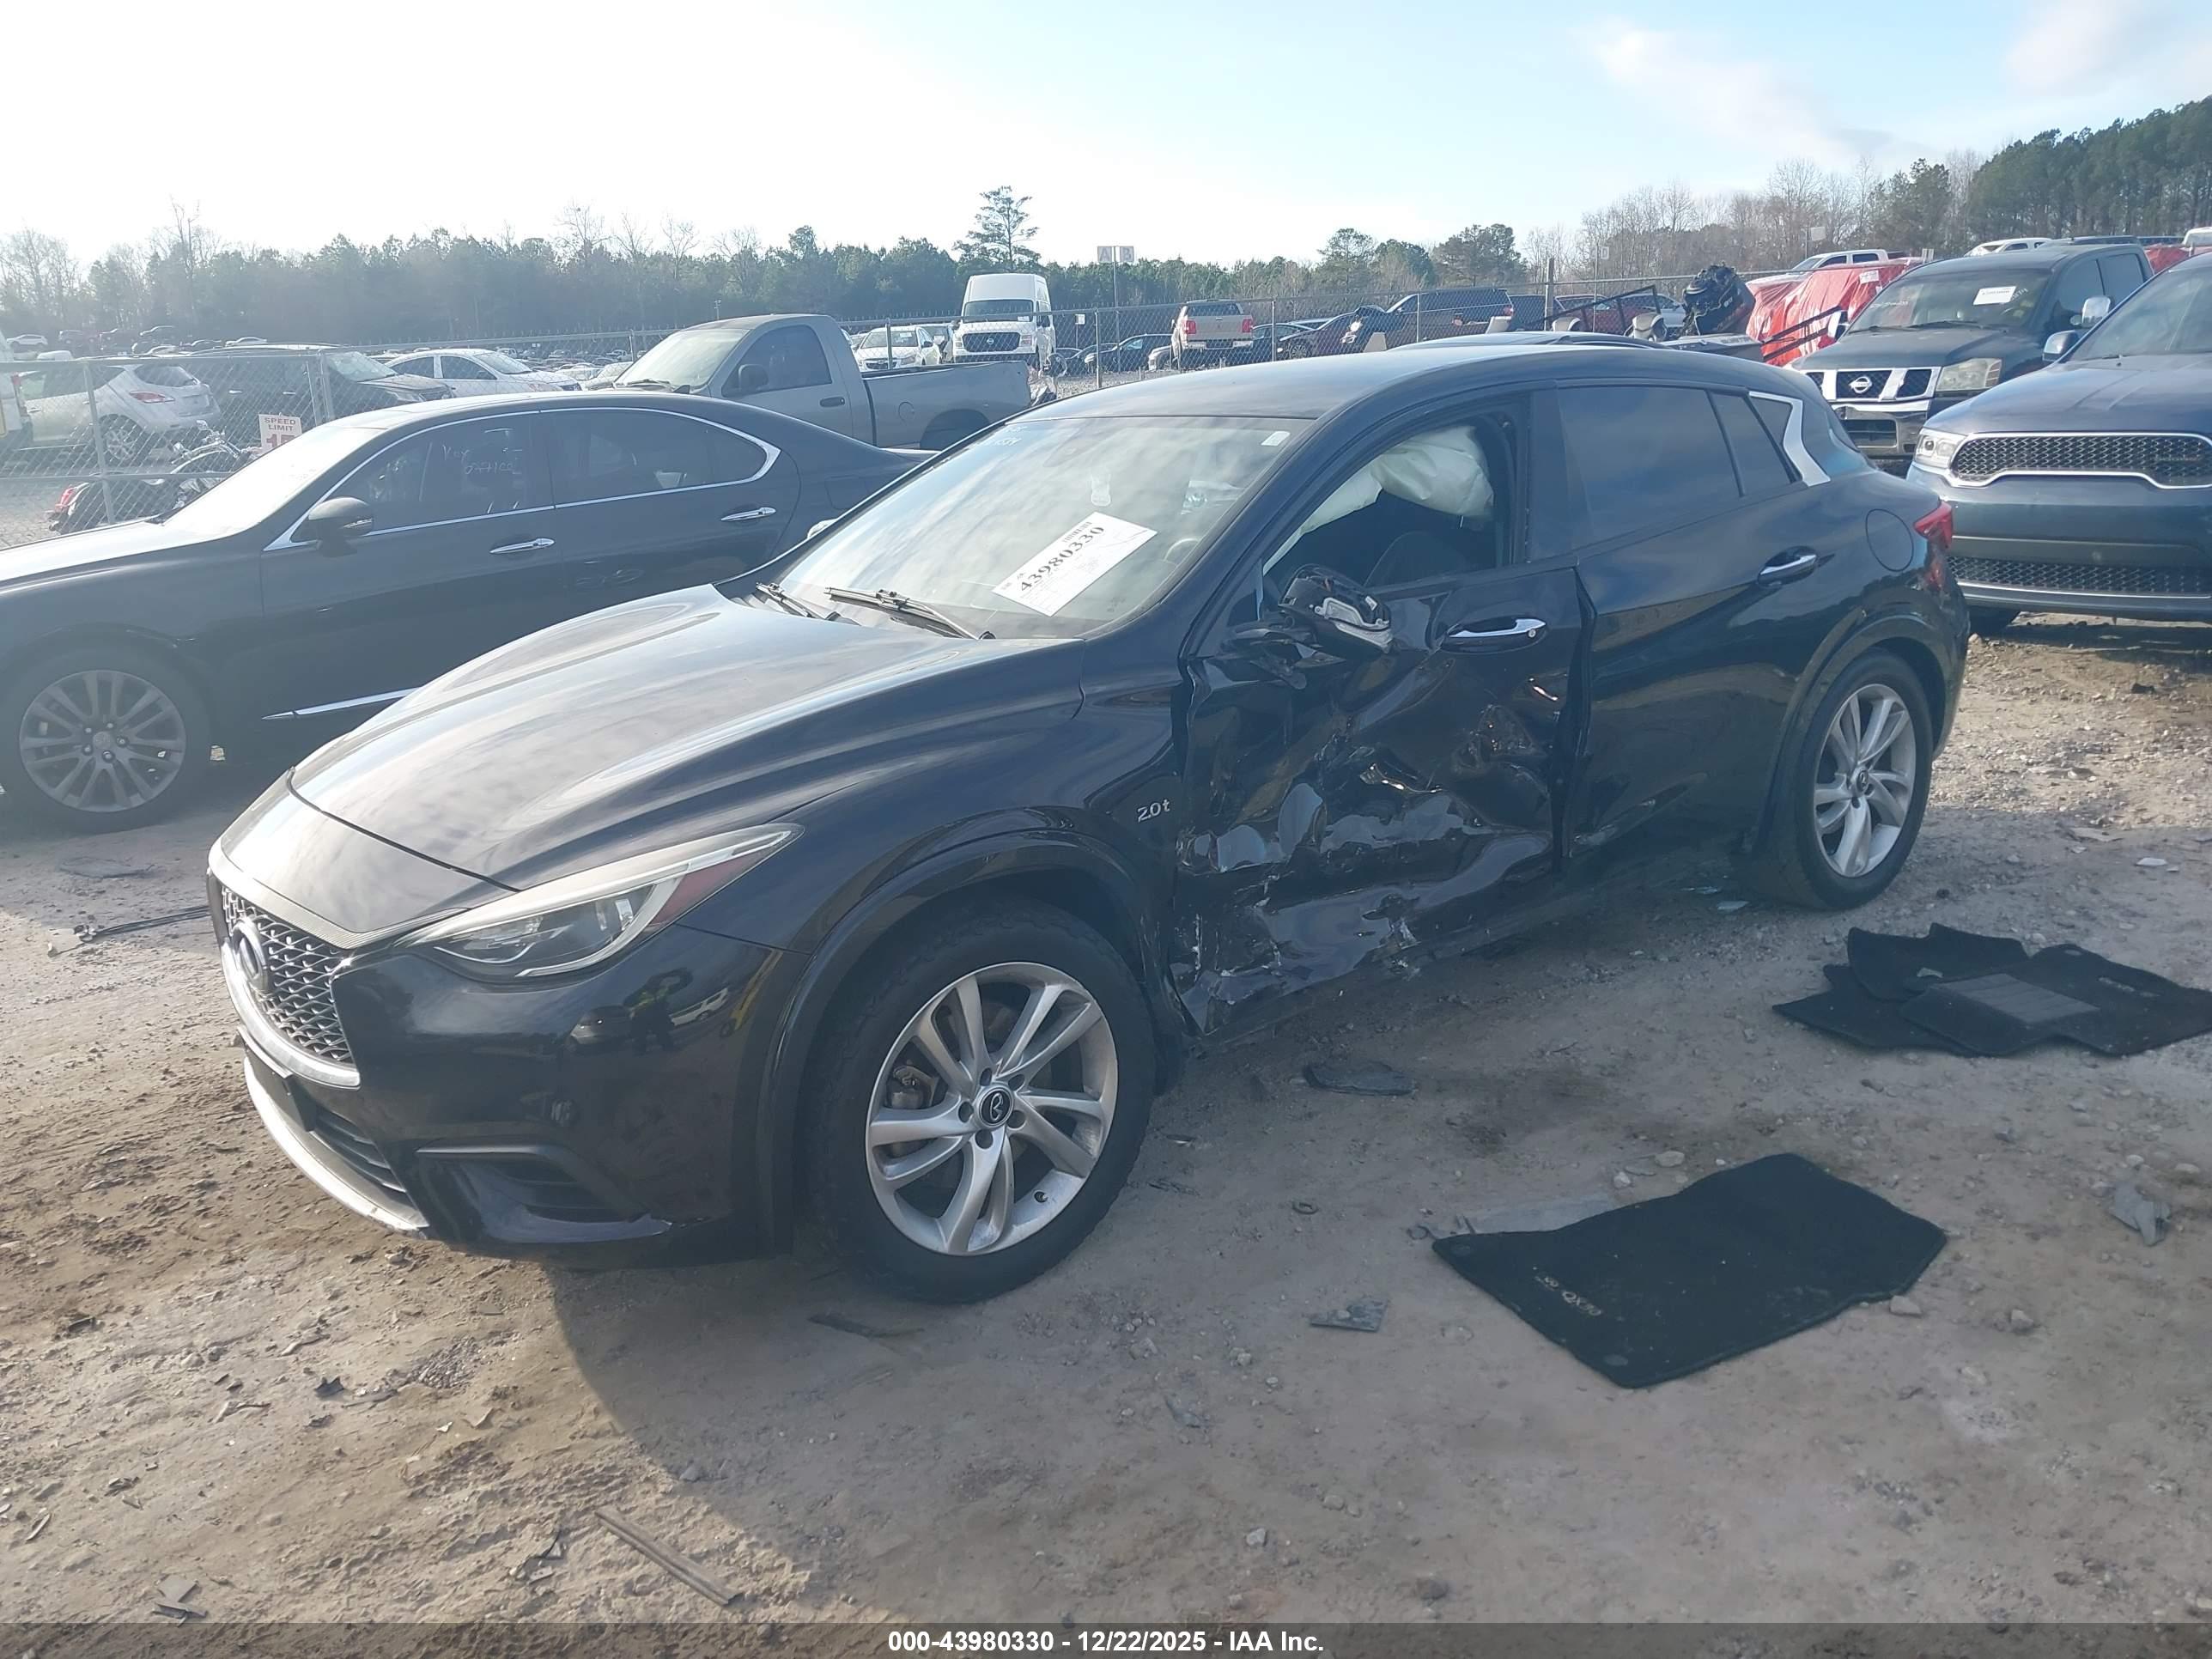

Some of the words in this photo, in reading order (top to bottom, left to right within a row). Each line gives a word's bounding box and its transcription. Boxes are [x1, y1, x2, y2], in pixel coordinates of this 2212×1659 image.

[1099, 247, 1110, 261] A
[1122, 247, 1132, 261] B
[1020, 526, 1105, 592] 43980330
